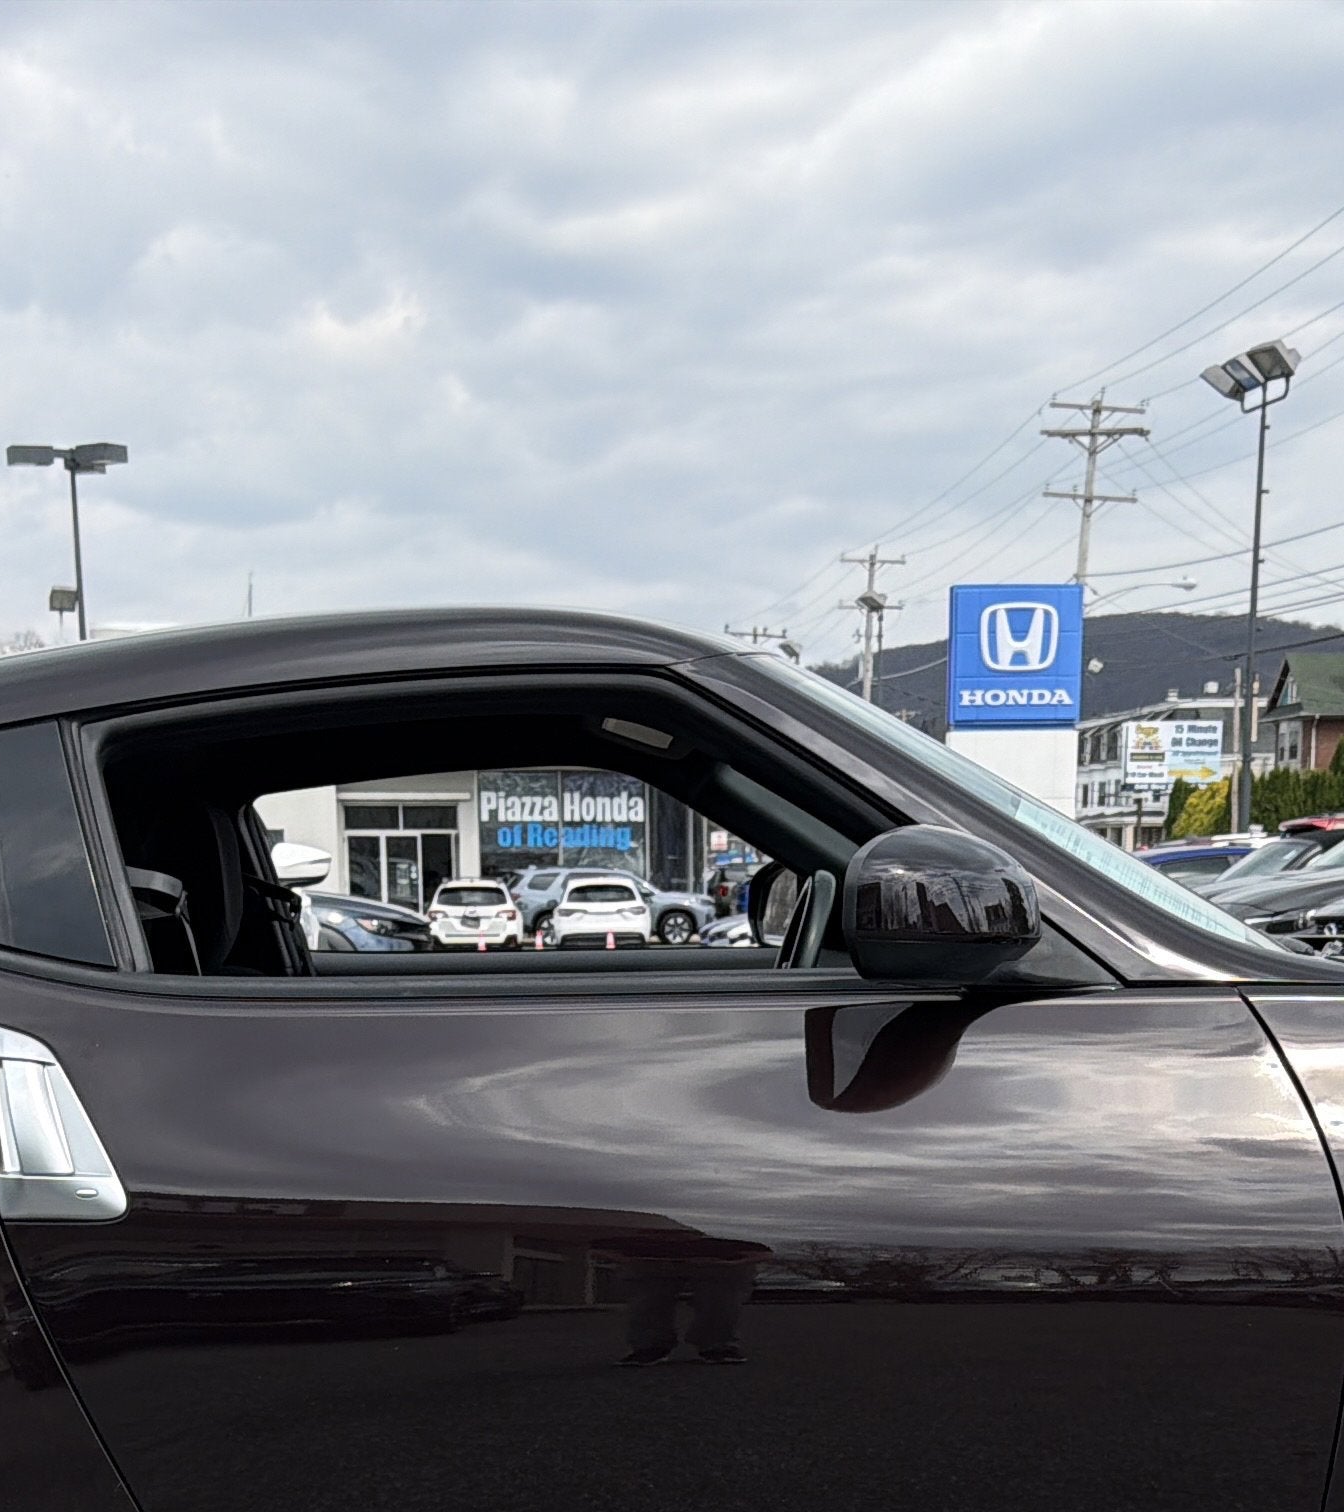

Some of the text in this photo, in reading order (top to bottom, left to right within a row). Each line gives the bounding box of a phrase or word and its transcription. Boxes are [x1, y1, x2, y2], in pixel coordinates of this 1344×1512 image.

[959, 688, 1073, 707] HONDA
[480, 791, 645, 823] Piazza Honda
[497, 824, 633, 851] of Reading
